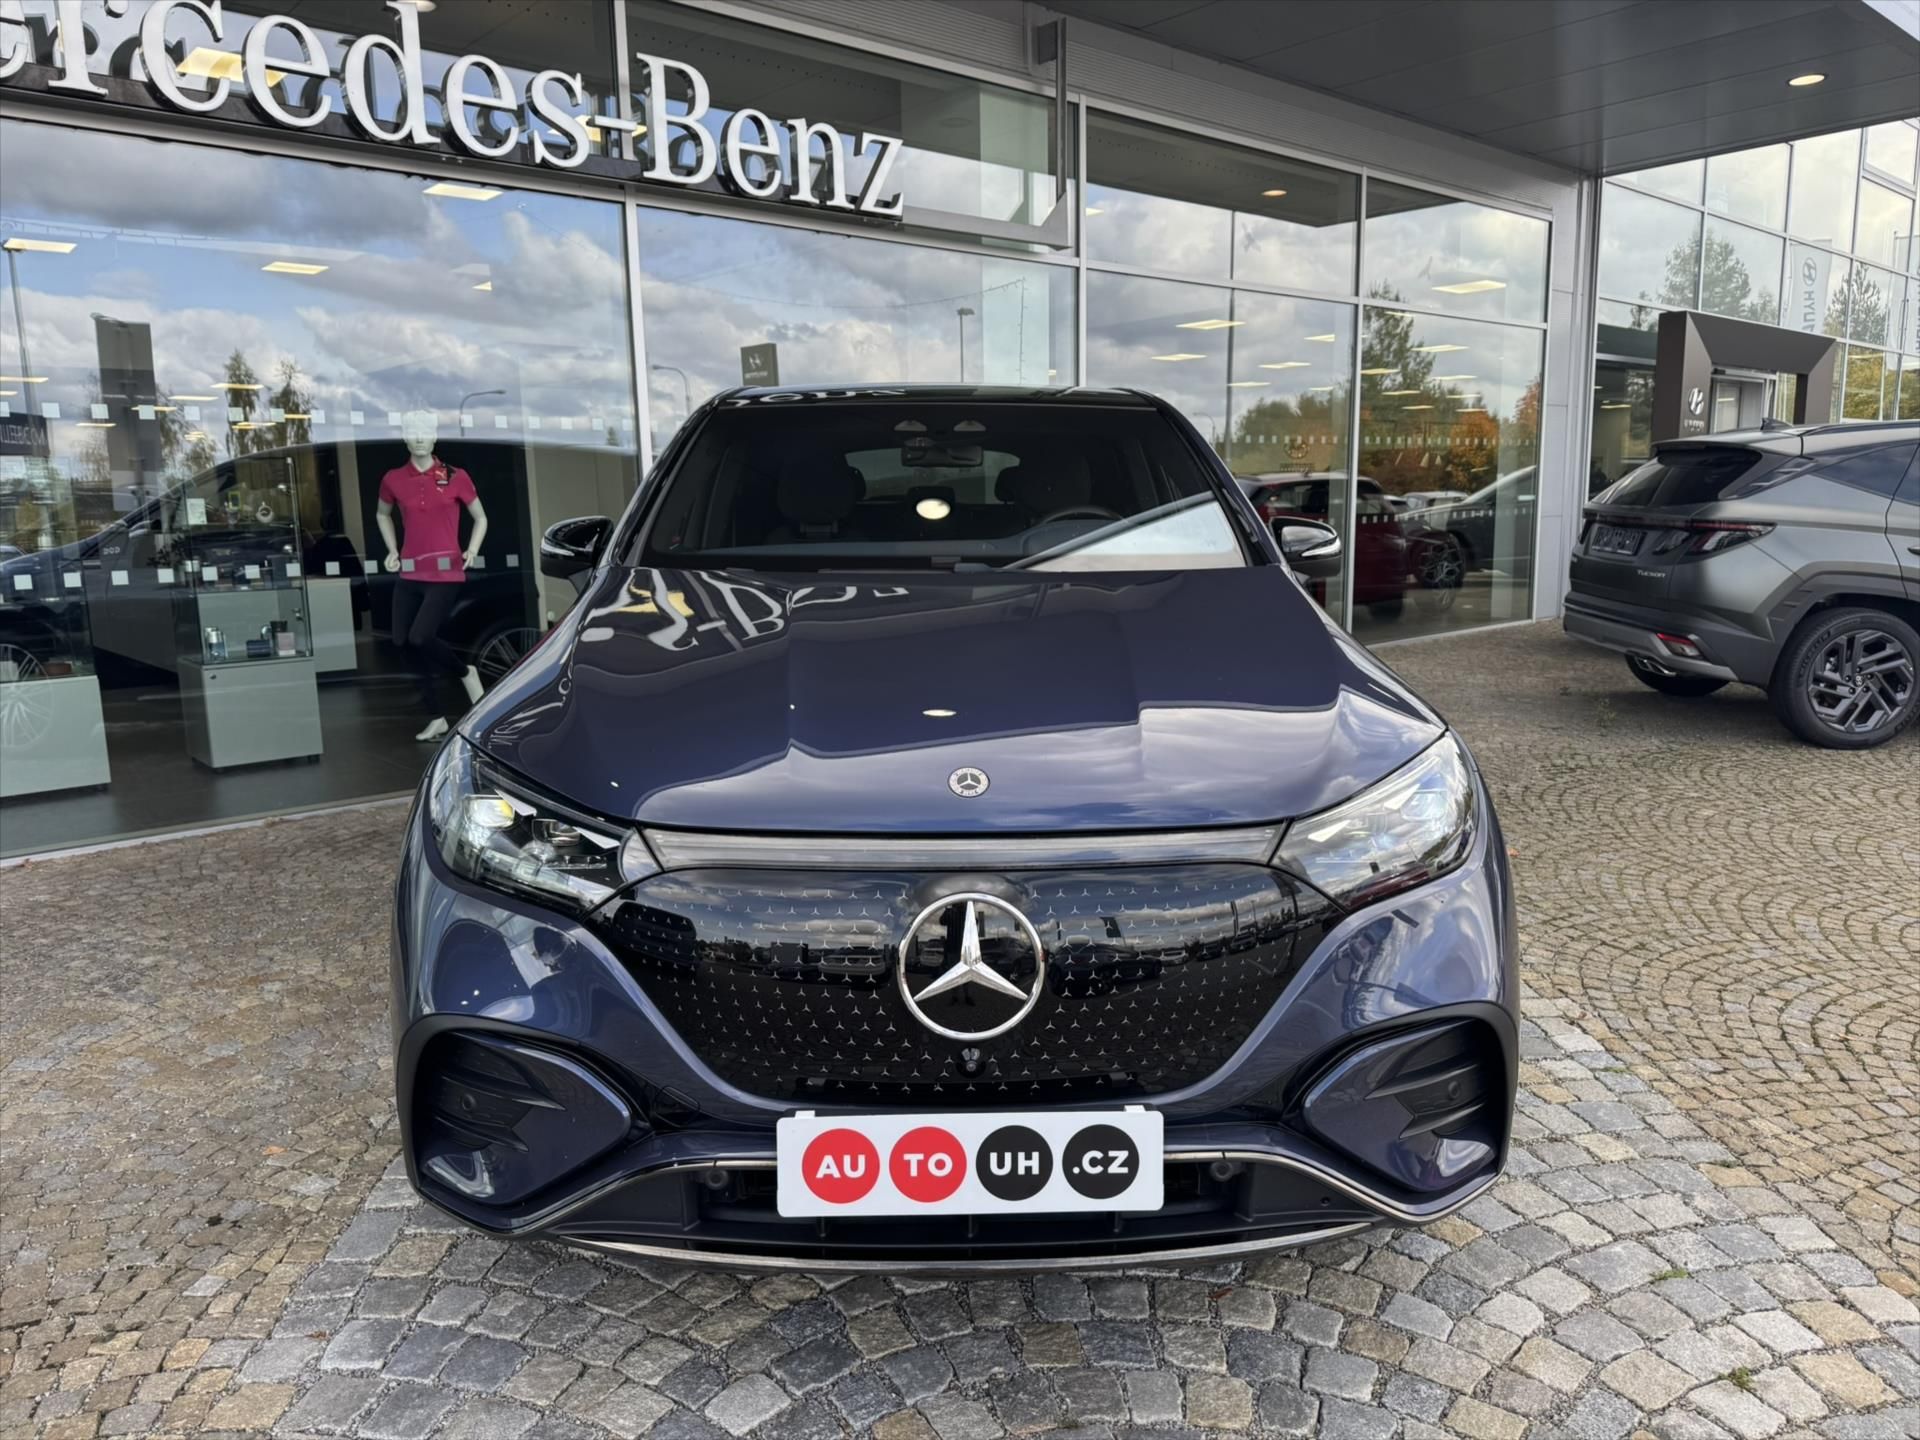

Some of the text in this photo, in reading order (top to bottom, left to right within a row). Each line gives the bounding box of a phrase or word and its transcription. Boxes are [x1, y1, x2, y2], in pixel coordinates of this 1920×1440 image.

[815, 1150, 1129, 1179] AU TO UH .CZ
